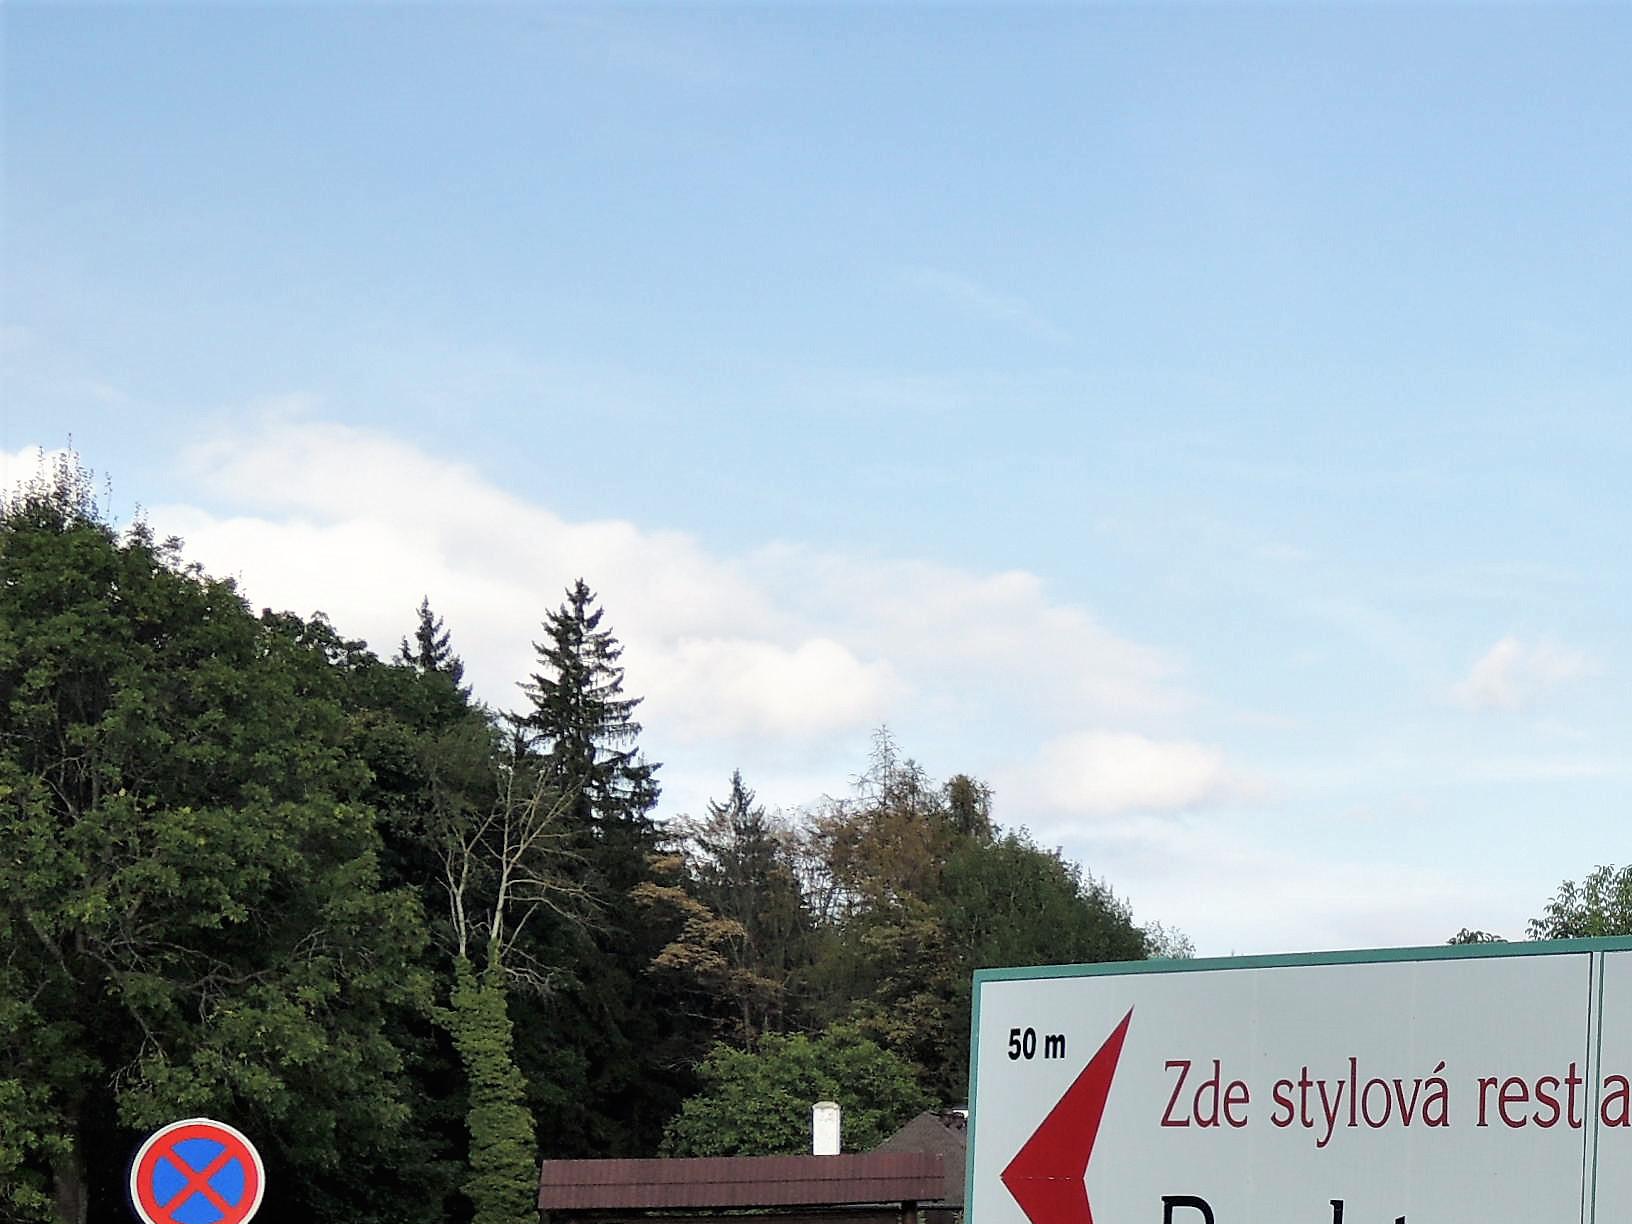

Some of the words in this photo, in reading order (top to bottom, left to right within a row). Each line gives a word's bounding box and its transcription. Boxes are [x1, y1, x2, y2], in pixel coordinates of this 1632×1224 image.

[1007, 1027, 1037, 1061] 50
[1044, 1034, 1066, 1060] m
[1159, 1058, 1251, 1128] Zde
[1270, 1056, 1450, 1149] stylová
